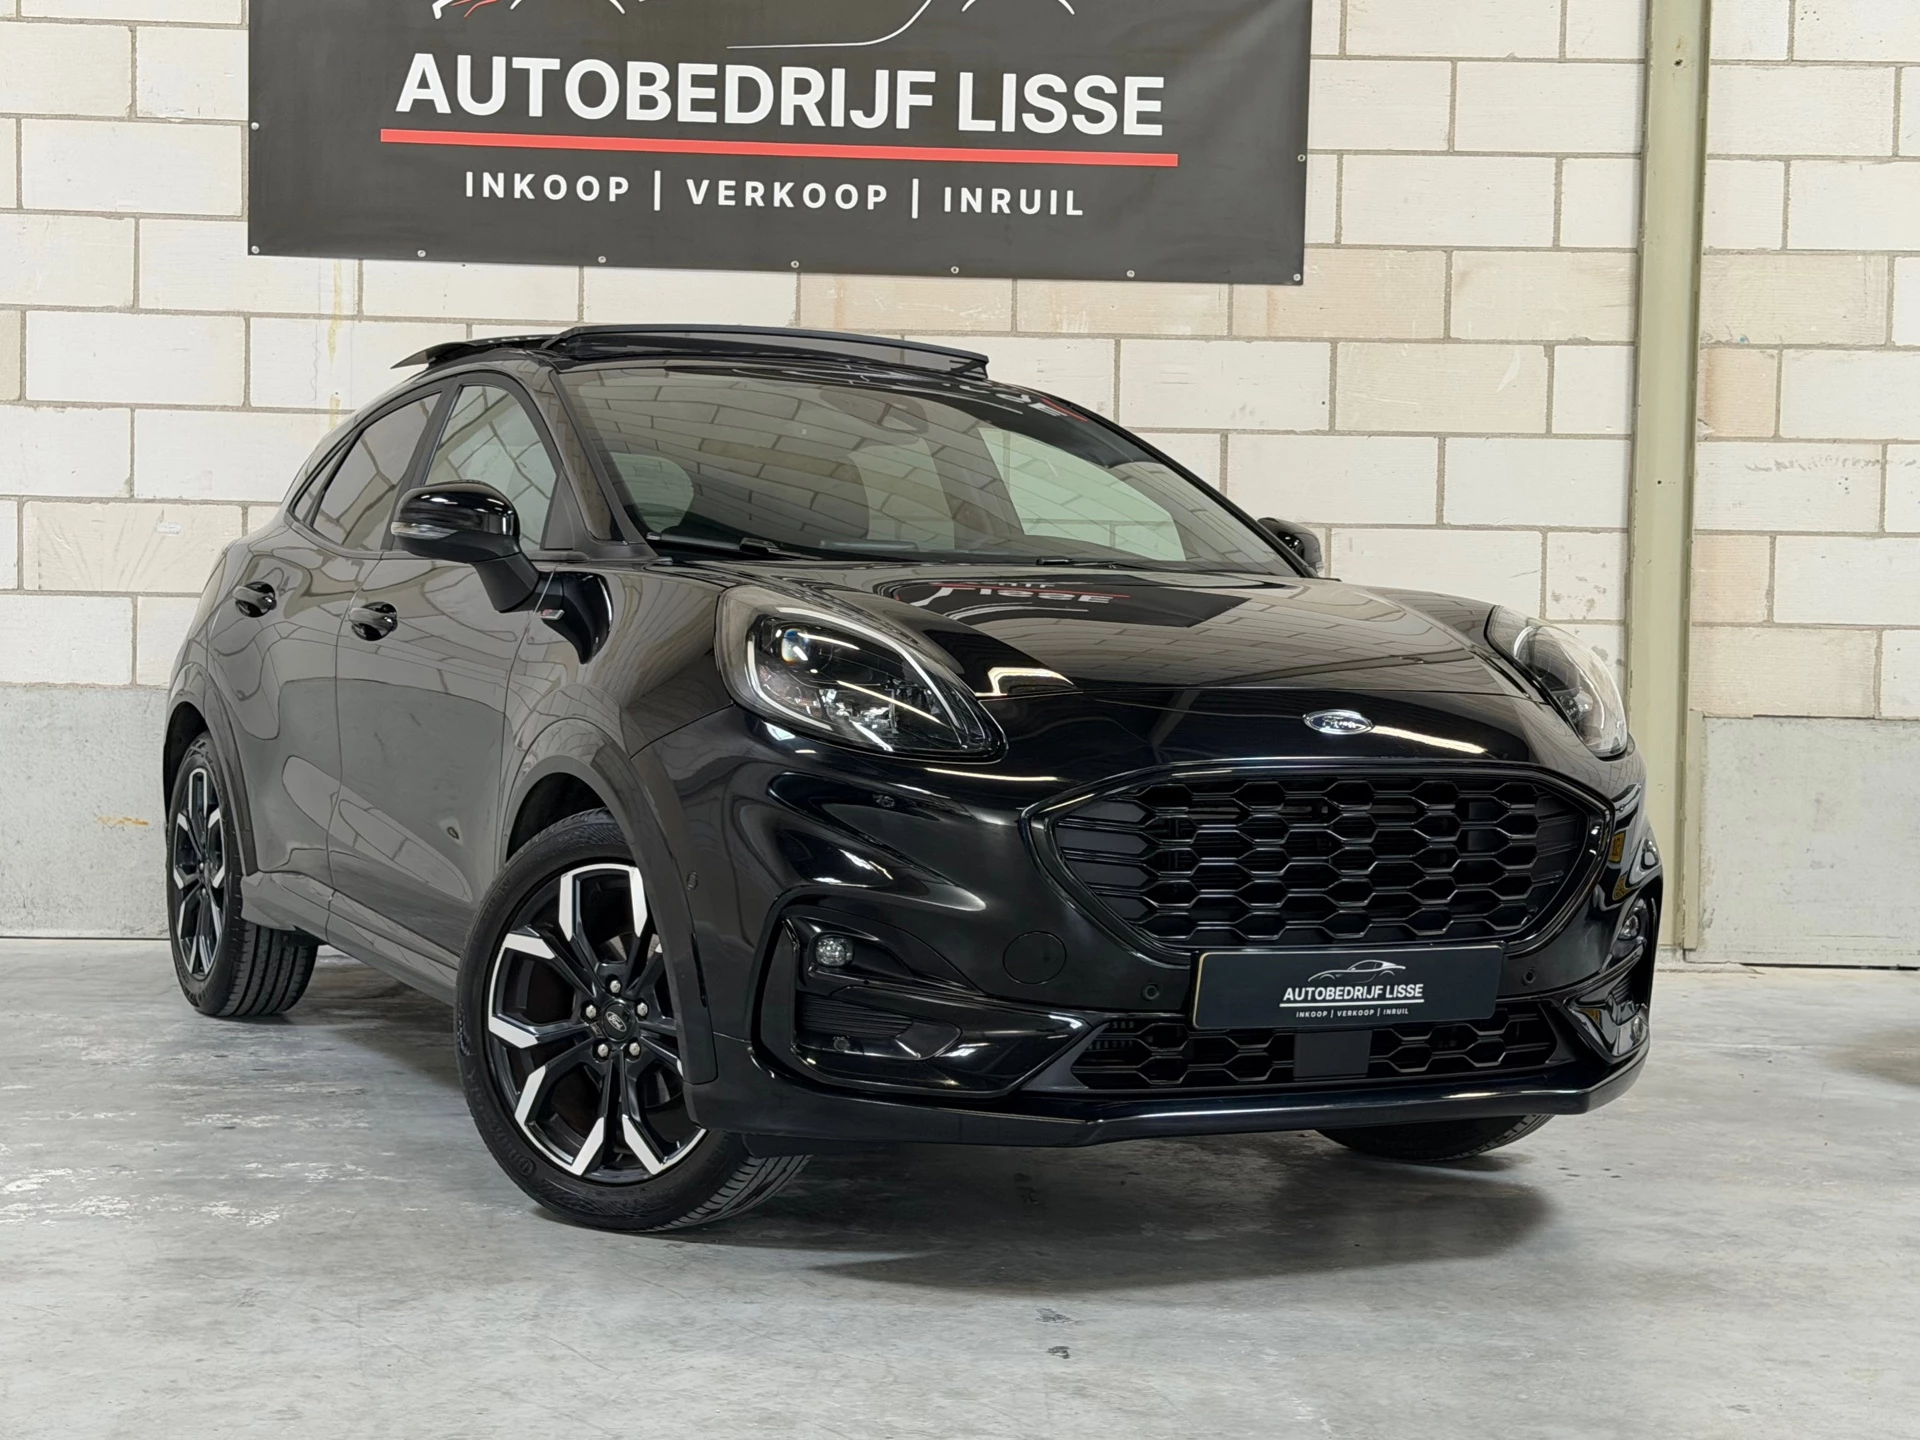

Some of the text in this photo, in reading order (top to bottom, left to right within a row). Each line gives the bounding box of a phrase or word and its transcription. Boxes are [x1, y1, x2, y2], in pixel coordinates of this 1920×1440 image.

[395, 52, 1165, 136] AUTOBEDRIJF LISSE
[465, 171, 629, 202] INKOOP
[685, 178, 887, 211] VERKOOP
[944, 186, 1084, 217] INRUIL
[1283, 983, 1424, 1001] AUTOBEDRIJF LISSE
[1295, 1010, 1328, 1018] INKOOP
[1336, 1009, 1375, 1017] VERKOOP
